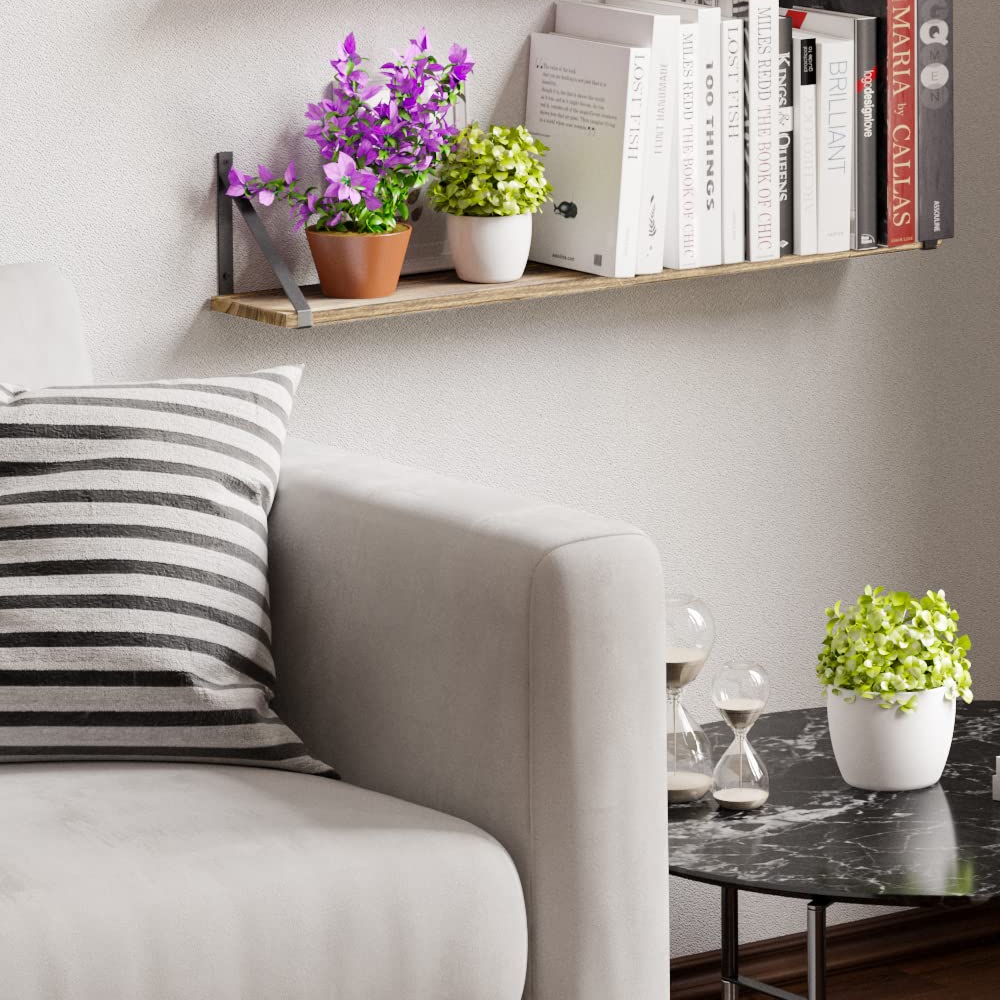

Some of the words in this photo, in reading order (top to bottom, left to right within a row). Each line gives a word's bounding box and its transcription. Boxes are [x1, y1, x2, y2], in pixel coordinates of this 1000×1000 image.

[757, 6, 772, 55] MILES
[892, 4, 911, 97] MARIA
[682, 32, 694, 78] MILES
[727, 27, 739, 81] LOST
[630, 54, 646, 108] LOST
[682, 81, 695, 121] REDD
[705, 60, 715, 106] 100
[757, 58, 772, 101] REDD
[727, 92, 740, 139] FISH
[757, 104, 772, 137] THE
[827, 59, 849, 174] BRILLIANT
[897, 101, 906, 116] by
[627, 114, 642, 160] FISH
[682, 123, 695, 154] THE
[682, 157, 695, 198] BOOK
[705, 116, 715, 212] THINGS
[757, 142, 772, 184] BOOK
[892, 123, 911, 227] CALLAS
[682, 200, 694, 217] OF
[757, 186, 772, 209] OF
[682, 222, 695, 259] CHIC
[757, 211, 772, 250] CHIC
